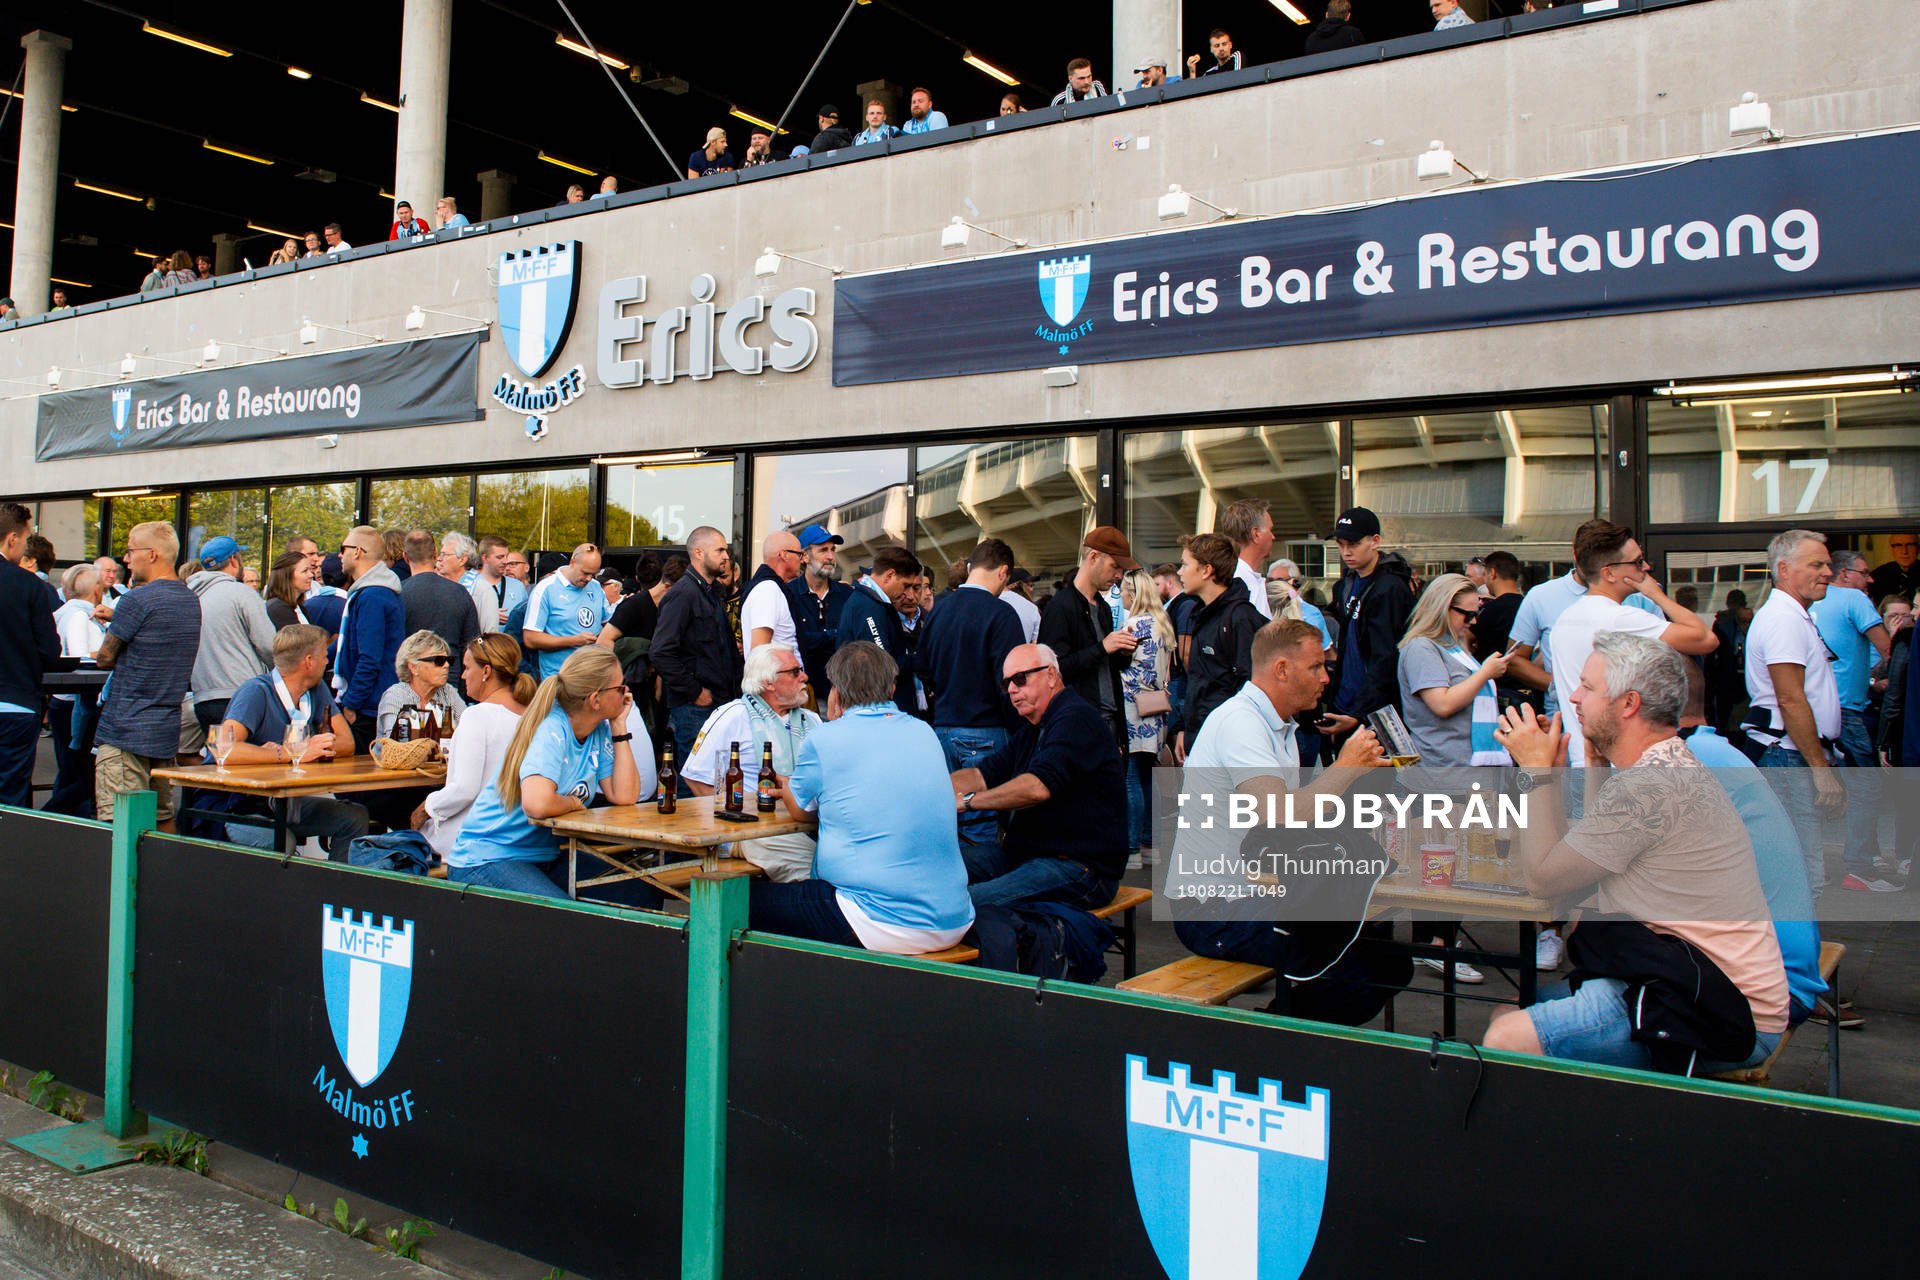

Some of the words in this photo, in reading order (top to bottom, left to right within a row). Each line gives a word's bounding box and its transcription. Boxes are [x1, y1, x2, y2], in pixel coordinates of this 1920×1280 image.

[1113, 271, 1218, 322] Erics
[1240, 255, 1333, 308] Bar
[1352, 241, 1394, 295] &
[1418, 208, 1820, 289] Restaurang
[597, 273, 819, 389] Erics
[1034, 324, 1079, 342] Malmö
[1079, 319, 1094, 336] FF
[136, 400, 174, 430] Erics
[179, 394, 212, 425] Bar
[216, 389, 230, 421] &
[236, 383, 361, 418] Restaurang
[494, 376, 557, 410] Malmö
[556, 367, 581, 401] FF
[1752, 458, 1829, 515] 17
[652, 505, 685, 540] 15
[312, 1064, 386, 1129] Malmö
[389, 1089, 416, 1127] FF
